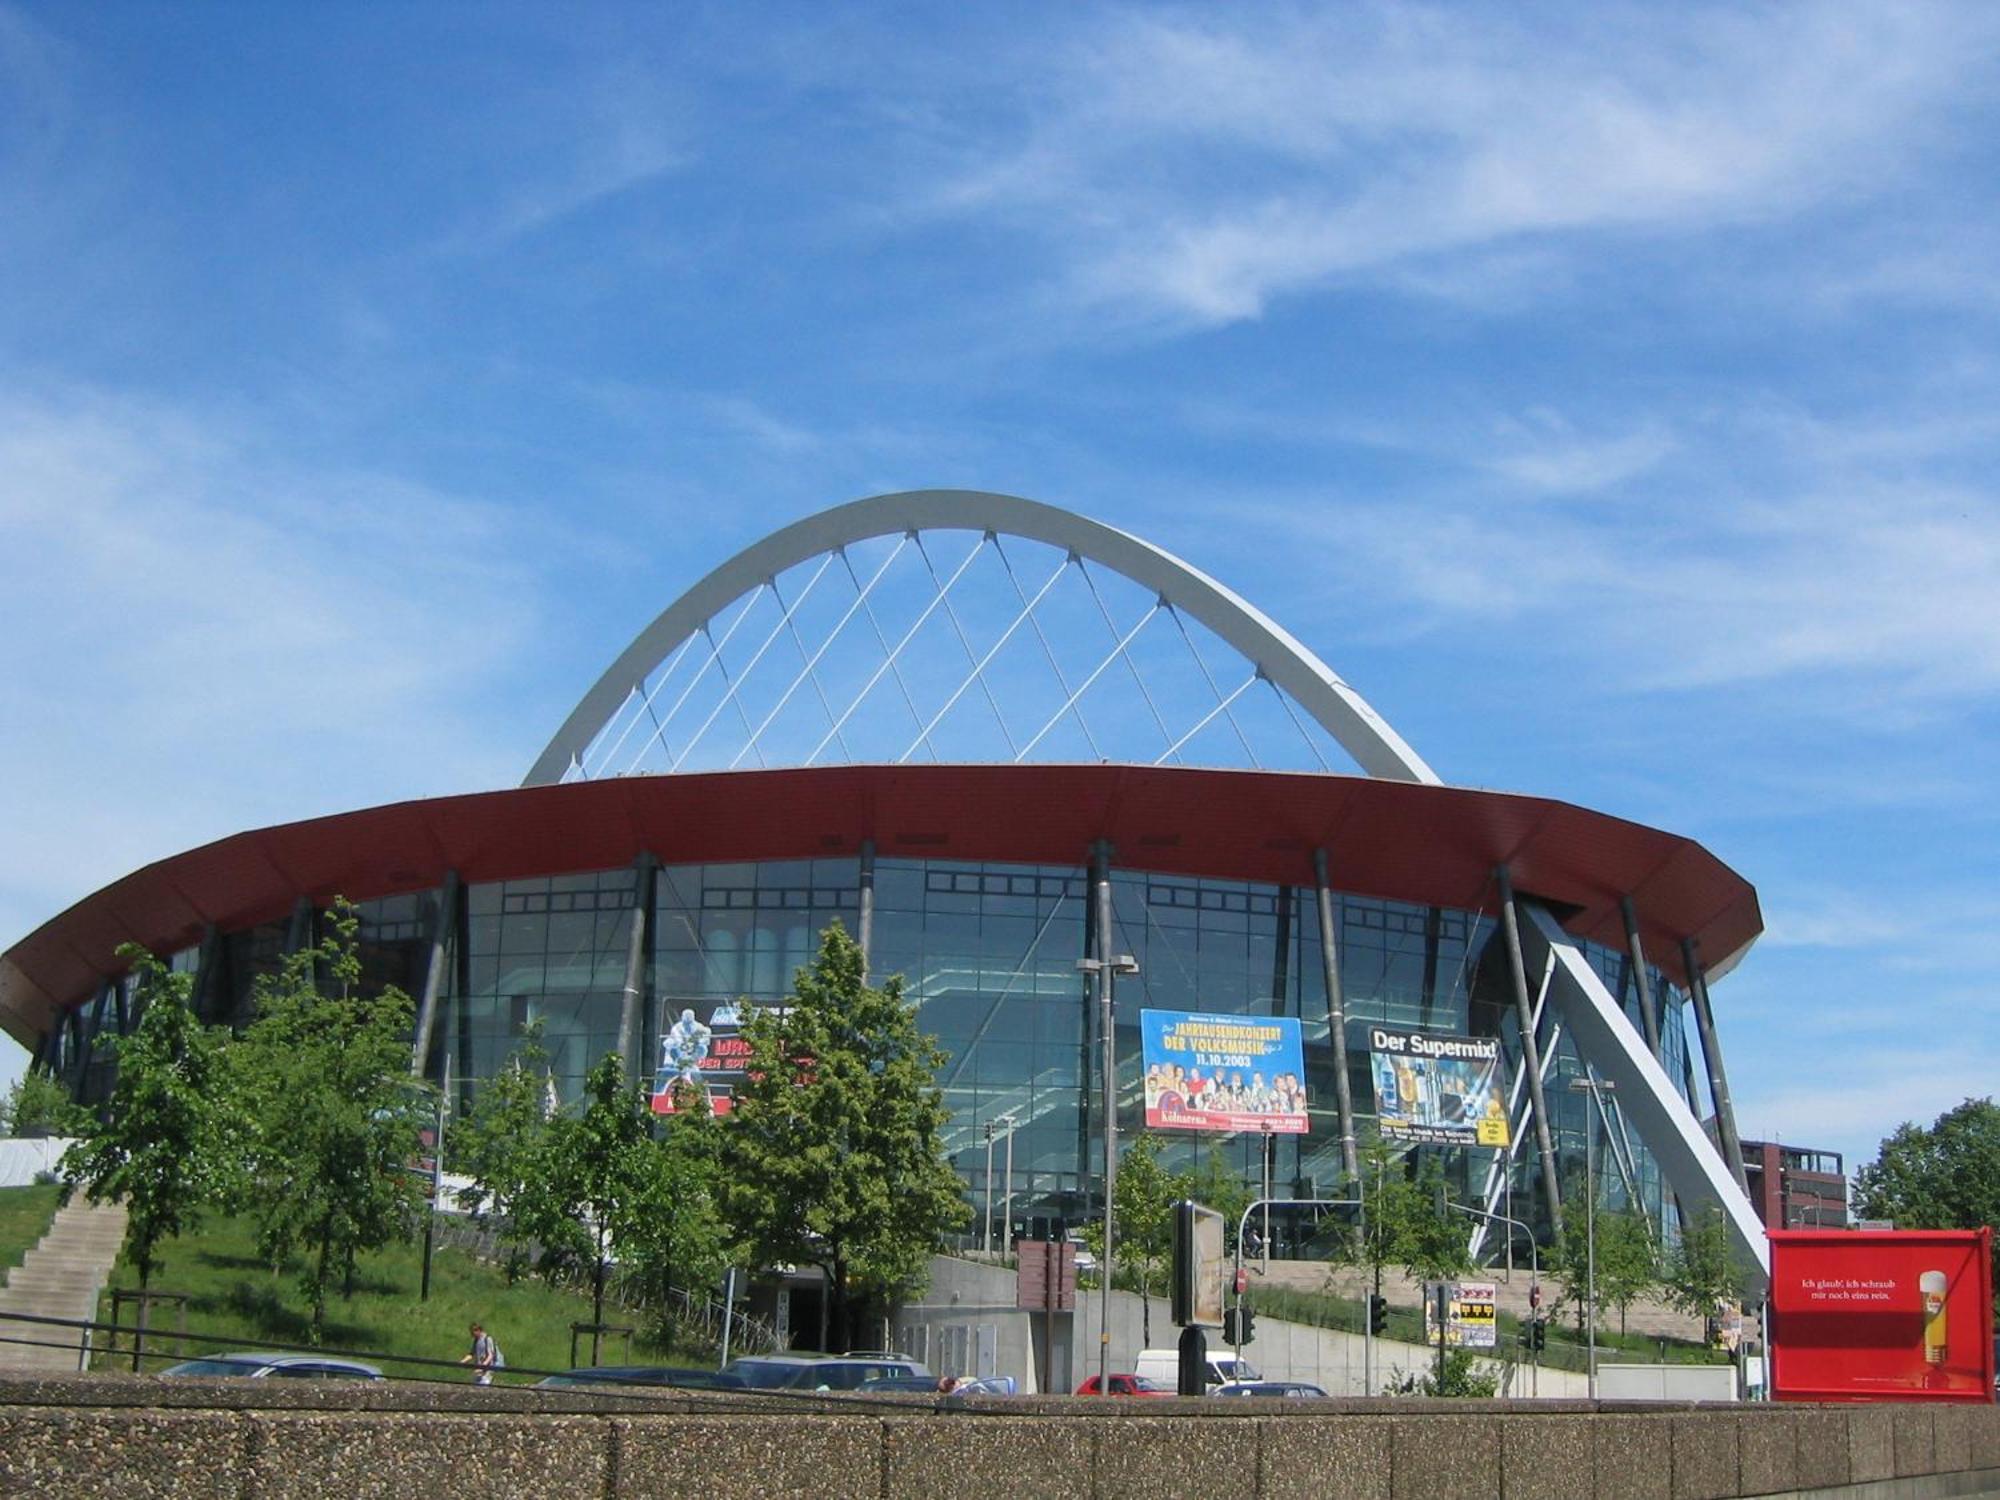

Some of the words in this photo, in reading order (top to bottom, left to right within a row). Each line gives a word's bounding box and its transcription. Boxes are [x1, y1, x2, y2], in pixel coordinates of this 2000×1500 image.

[1163, 1036, 1186, 1051] DER
[1191, 1038, 1266, 1055] VOLKSMUSIK
[1374, 1031, 1406, 1051] Der
[1410, 1035, 1496, 1058] Supermix!
[1196, 1053, 1251, 1067] 11.10.2003
[1160, 1110, 1207, 1124] Kölnarena
[1802, 1279, 1815, 1288] Ich
[1846, 1279, 1860, 1288] ich
[1861, 1279, 1896, 1288] schraub
[1811, 1291, 1826, 1299] mir
[1829, 1290, 1850, 1299] noch
[1851, 1291, 1869, 1299] eins
[1871, 1290, 1890, 1300] rein.
